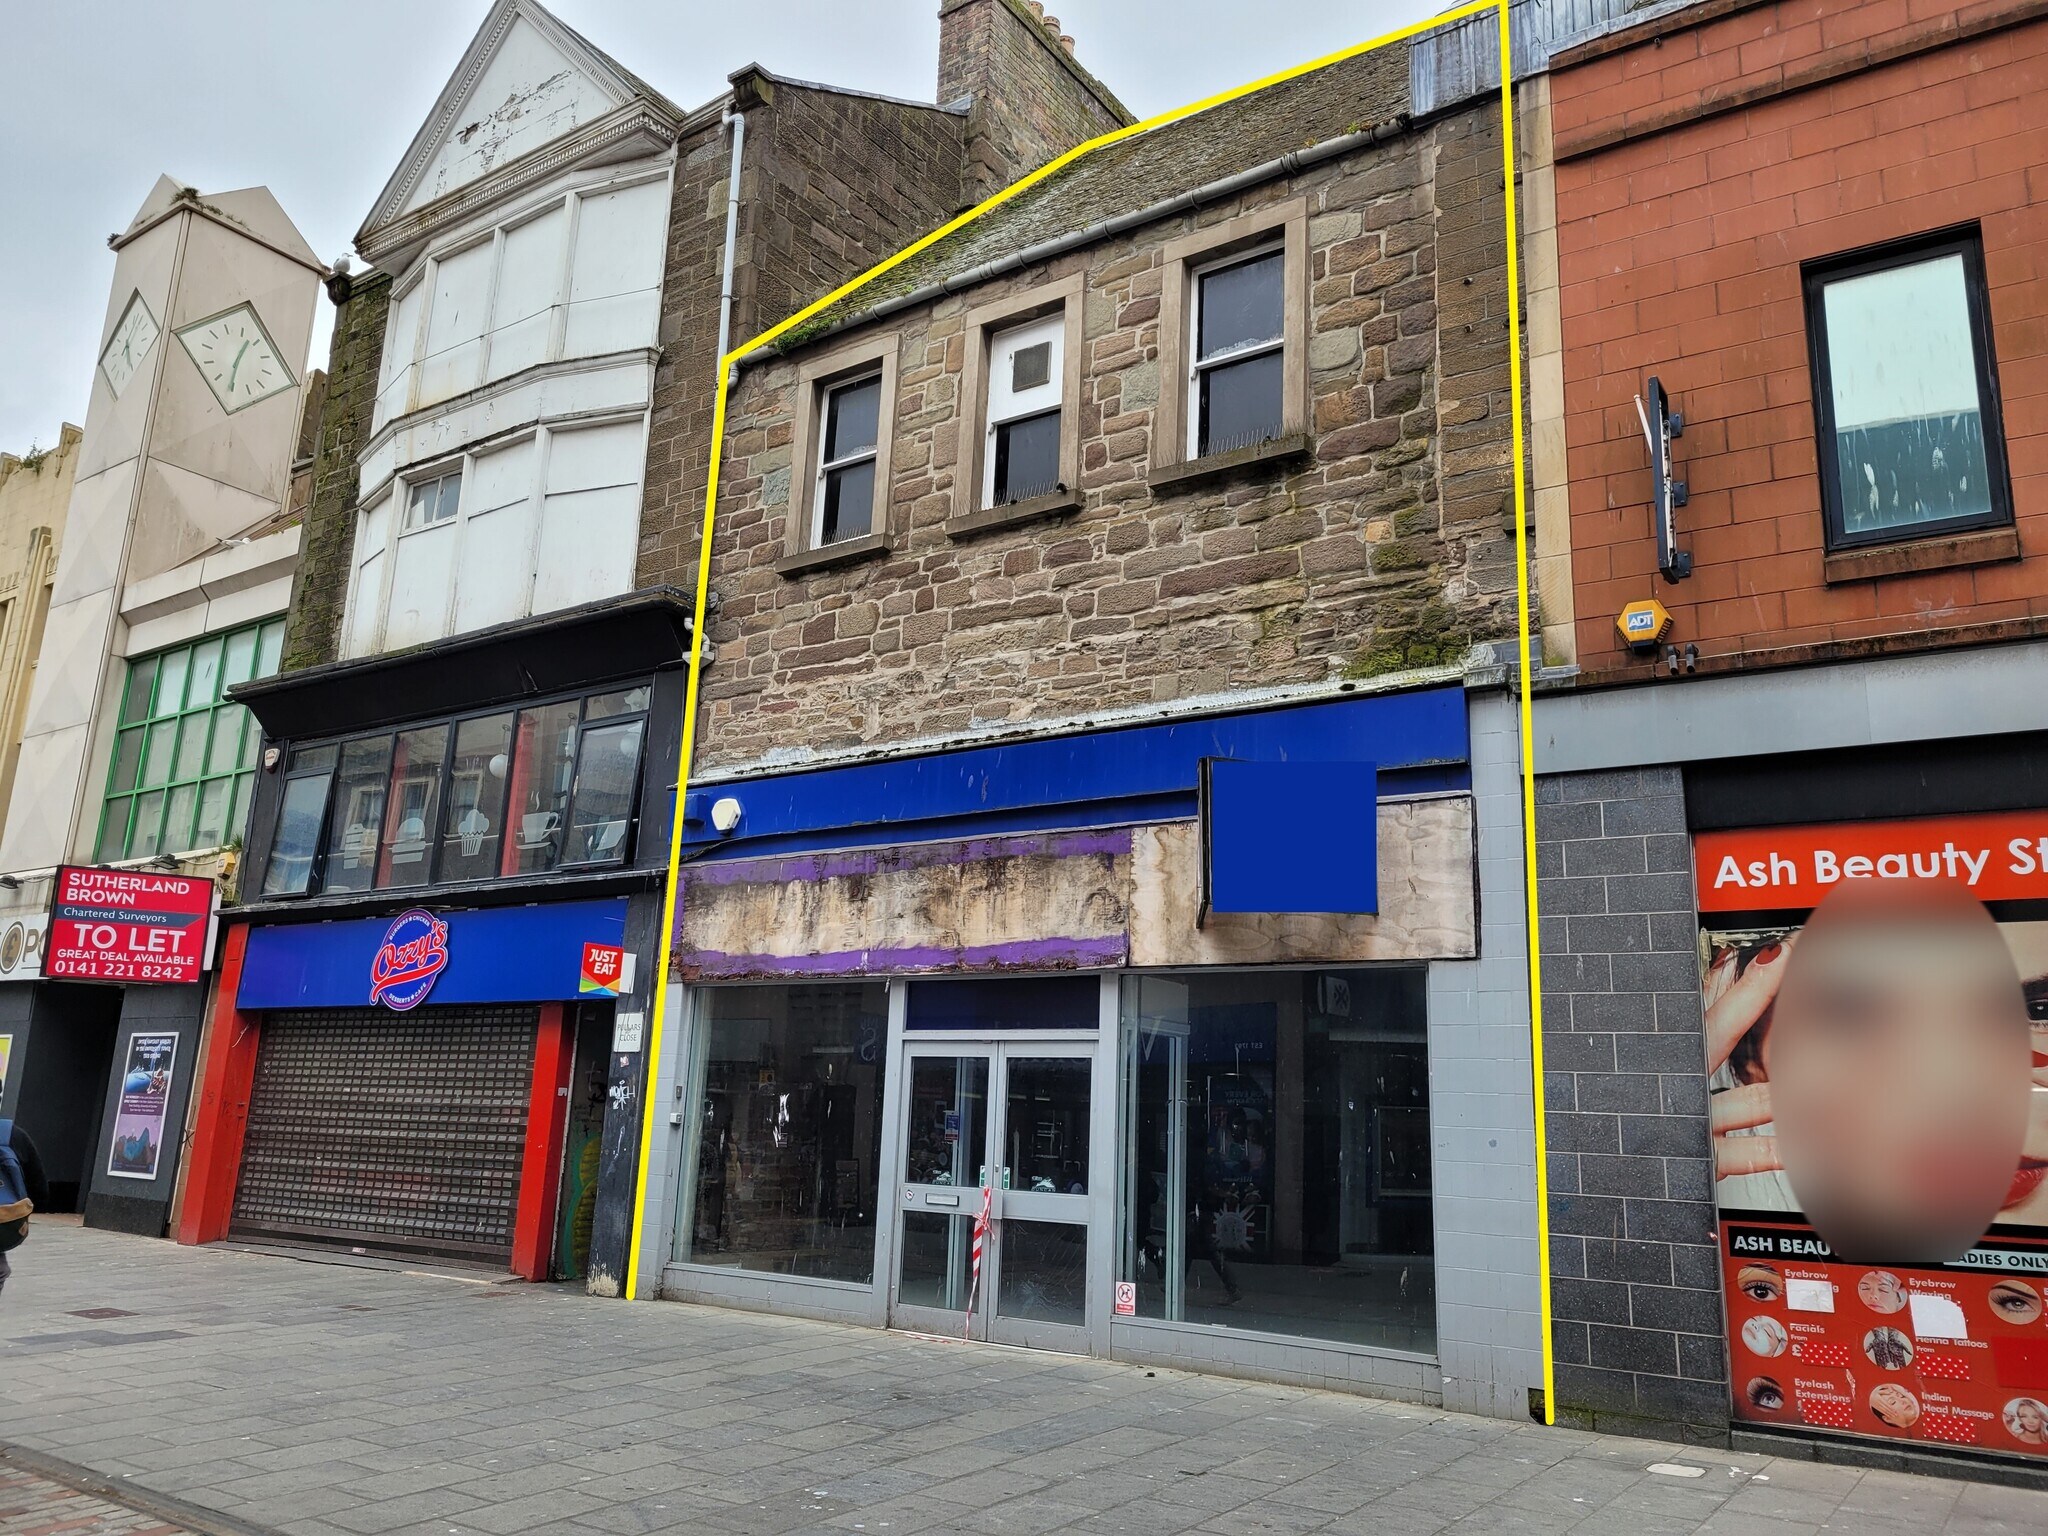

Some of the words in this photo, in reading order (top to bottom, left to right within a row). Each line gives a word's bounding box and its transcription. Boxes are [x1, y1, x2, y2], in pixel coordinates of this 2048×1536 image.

[1629, 613, 1654, 629] ADT
[1714, 852, 1798, 889] Ash
[1813, 842, 1991, 885] Beauty
[69, 872, 190, 895] SUTHERLAND
[66, 887, 135, 906] BROWN
[63, 907, 115, 920] Chartered
[118, 911, 167, 923] Surveyors
[388, 918, 410, 941] BURGERS
[412, 915, 431, 928] CHICKEN
[73, 923, 118, 949] TO
[128, 927, 187, 953] LET
[57, 948, 97, 961] GREAT
[99, 951, 130, 963] DEAL
[133, 953, 195, 966] AVAILABLE
[372, 919, 446, 985] Ozzy's
[589, 947, 618, 963] JUST
[54, 960, 98, 975] 0141
[104, 963, 135, 977] 221
[141, 965, 183, 979] 8242
[592, 961, 616, 976] EAT
[388, 992, 411, 1004] DESSERTS
[619, 1034, 637, 1042] CLOSE
[1734, 1235, 1773, 1252] ASH
[1779, 1238, 1839, 1257] BEAU
[1957, 1252, 2003, 1266] ADIES
[1784, 1268, 1829, 1280] Eyebrow
[1909, 1278, 1957, 1289] Eyebrow
[1789, 1323, 1825, 1334] Facials
[1953, 1338, 1989, 1349] Tattoos
[1794, 1378, 1835, 1391] Eyelash
[1795, 1389, 1851, 1403] Extensions
[1921, 1391, 1952, 1403] Indian
[1922, 1403, 1949, 1414] Head
[1951, 1406, 1995, 1420] Massage
